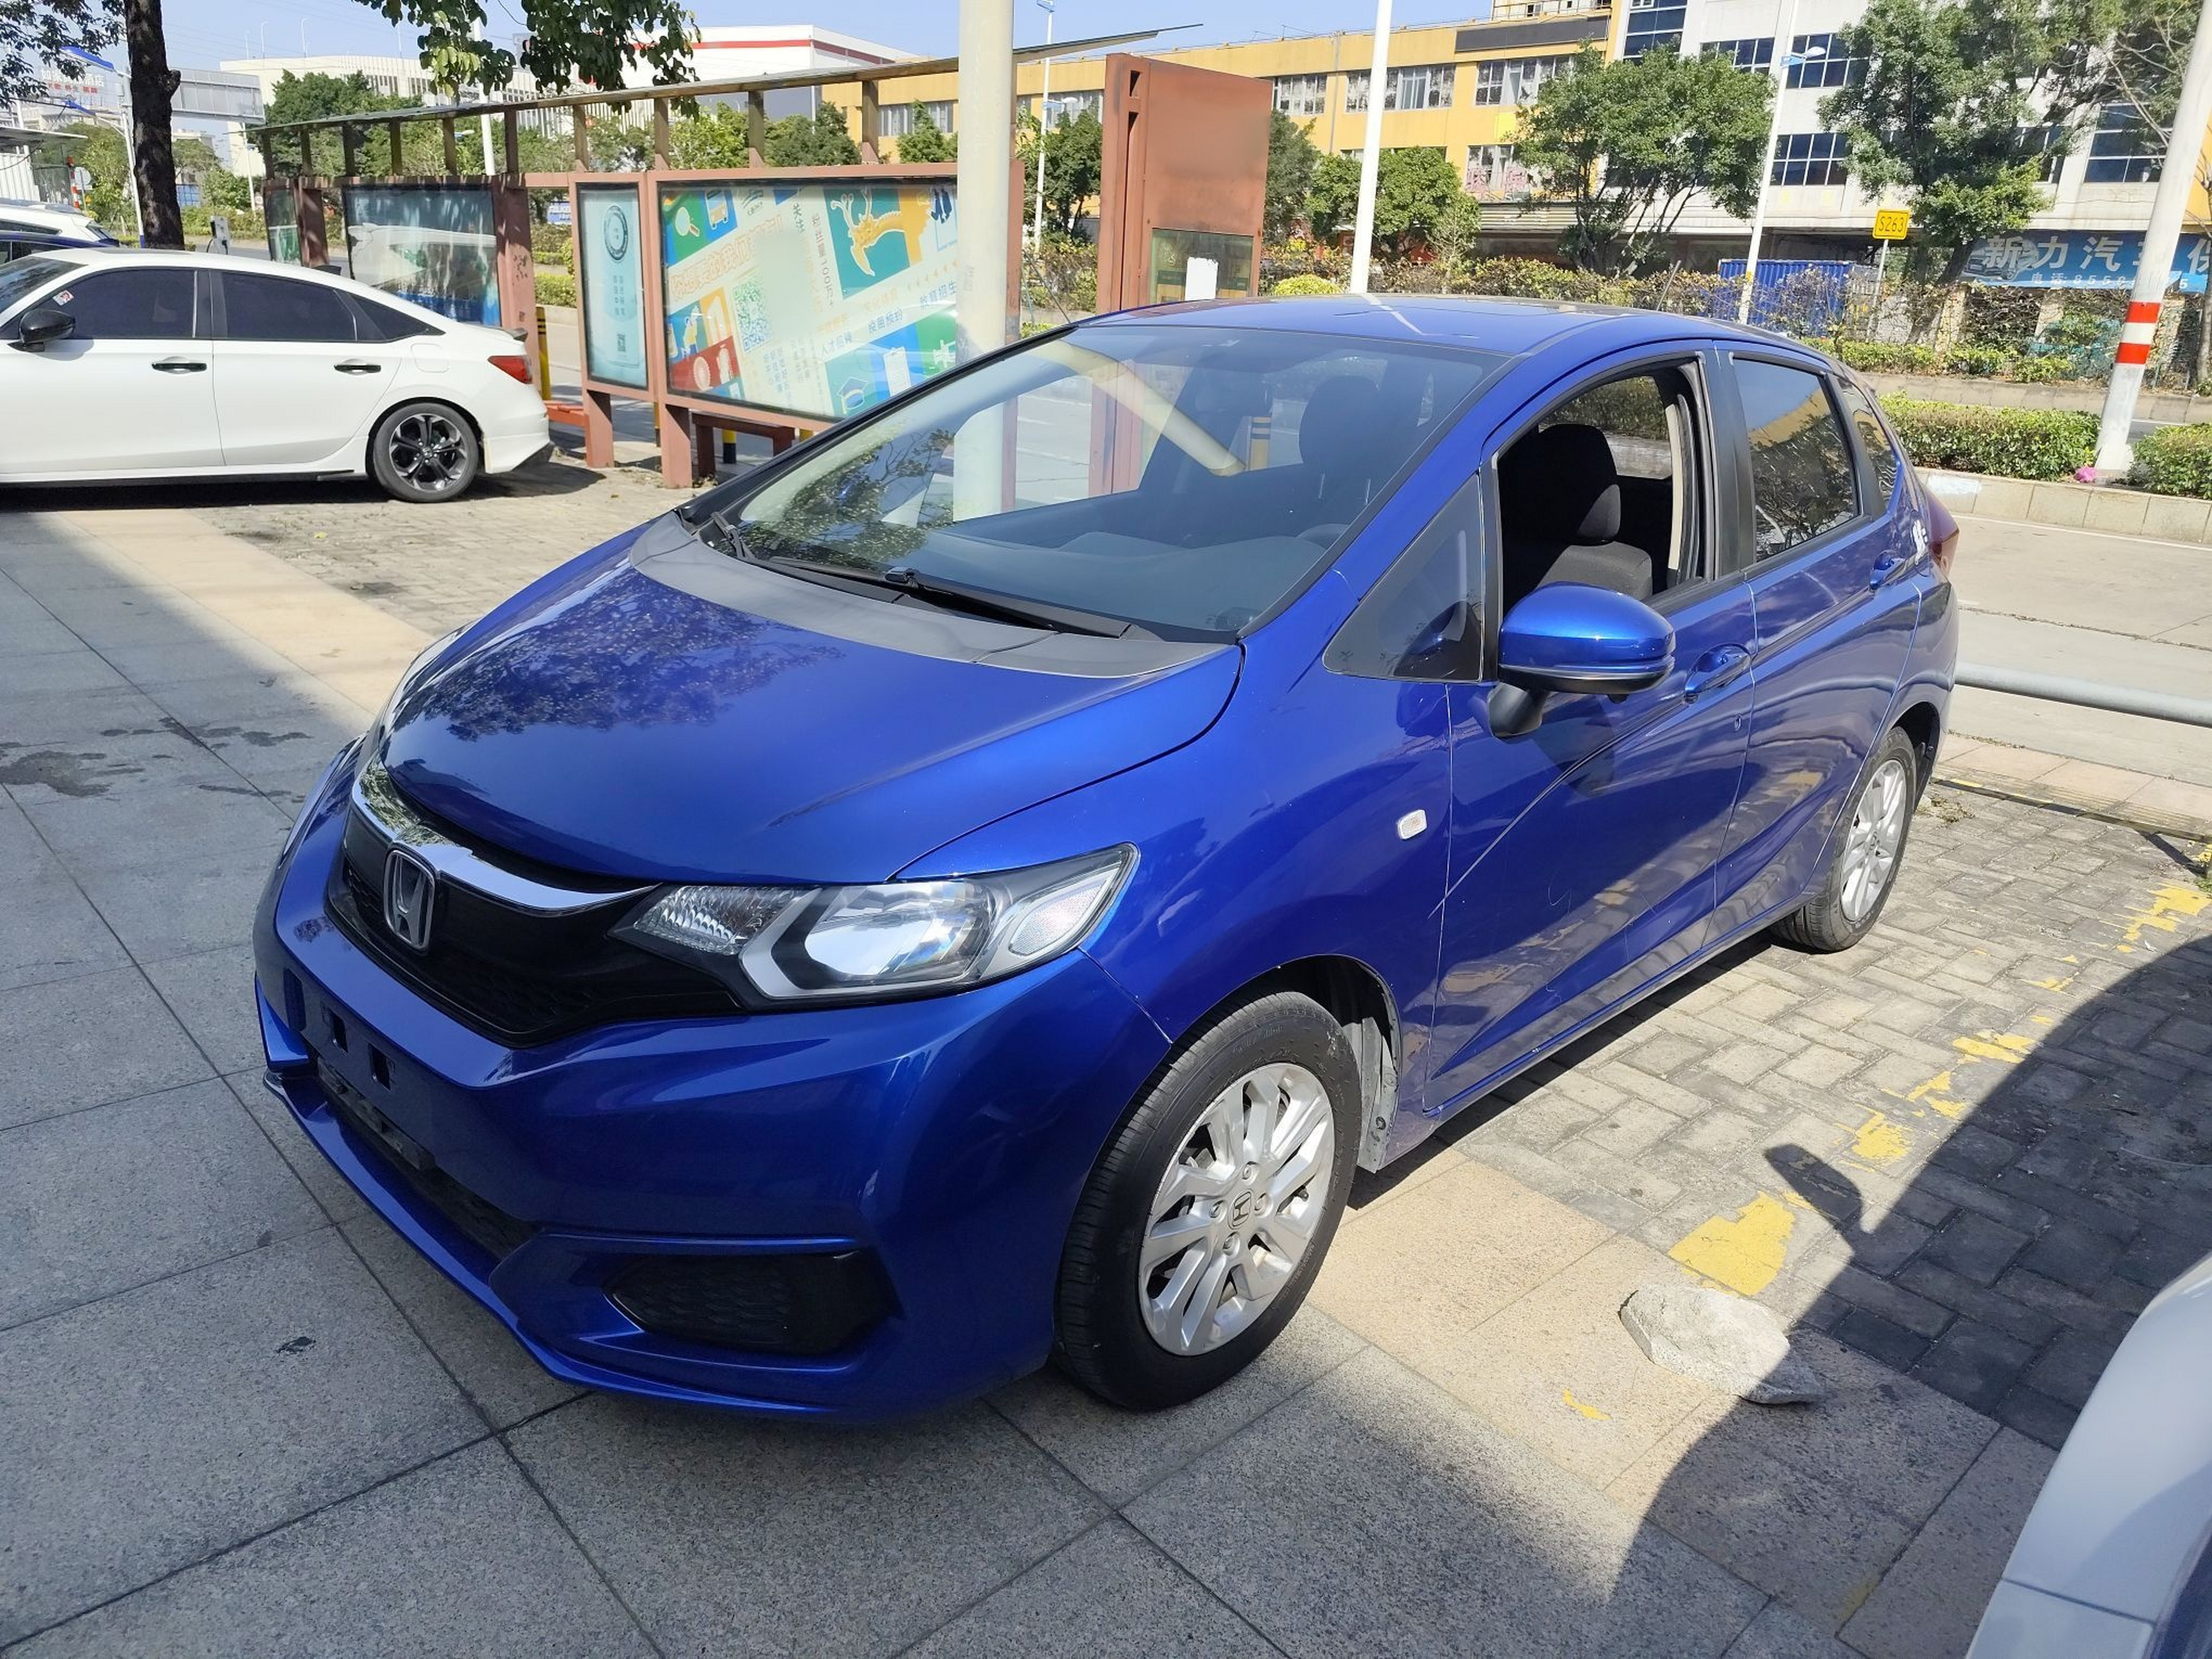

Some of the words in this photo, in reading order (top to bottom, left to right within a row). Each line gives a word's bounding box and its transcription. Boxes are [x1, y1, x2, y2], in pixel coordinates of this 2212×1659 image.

[41, 68, 104, 87] 如家酒店
[1878, 216, 1904, 233] S263
[1983, 235, 2211, 274] 新力汽保
